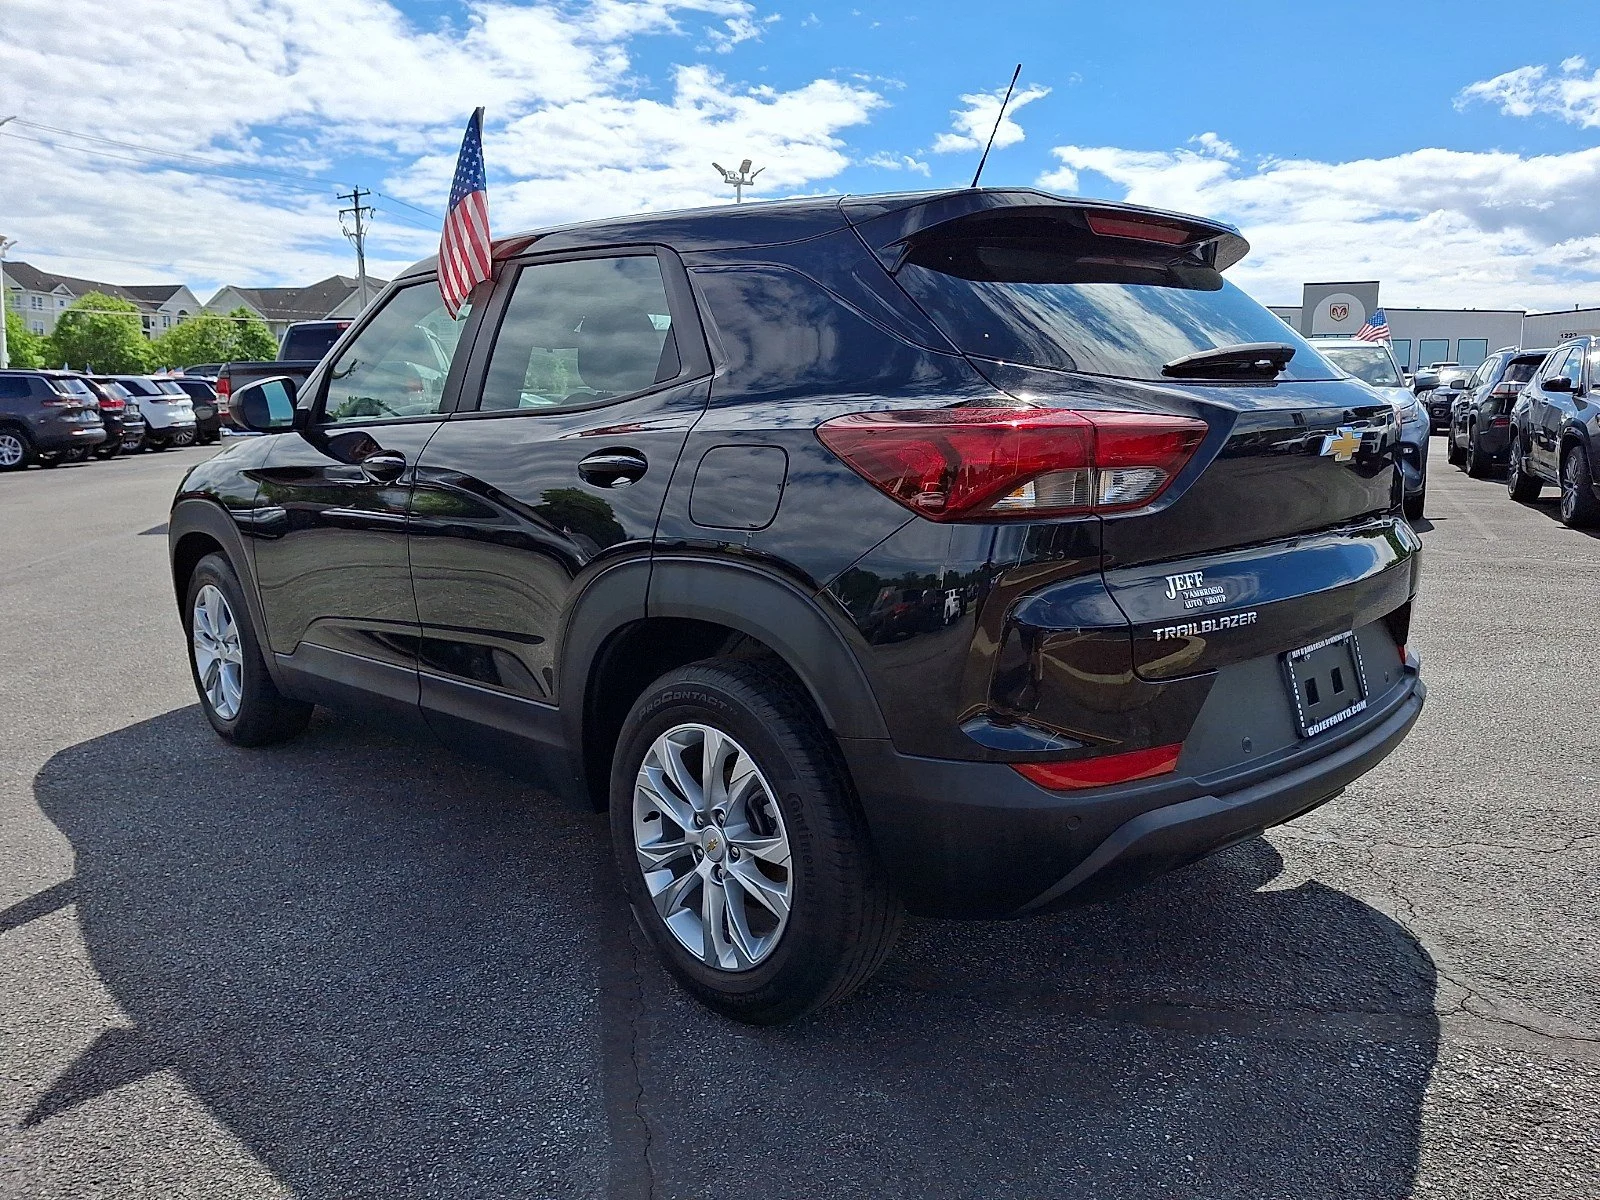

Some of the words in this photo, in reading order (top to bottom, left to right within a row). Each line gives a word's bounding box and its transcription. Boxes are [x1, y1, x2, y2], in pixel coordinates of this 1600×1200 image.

[1165, 571, 1203, 600] JEFF
[1184, 598, 1203, 609] AUTO
[1204, 594, 1227, 606] GROUP
[1152, 611, 1258, 642] TRAILBLAZER
[1307, 699, 1367, 737] GOJEFFAUTO.COM
